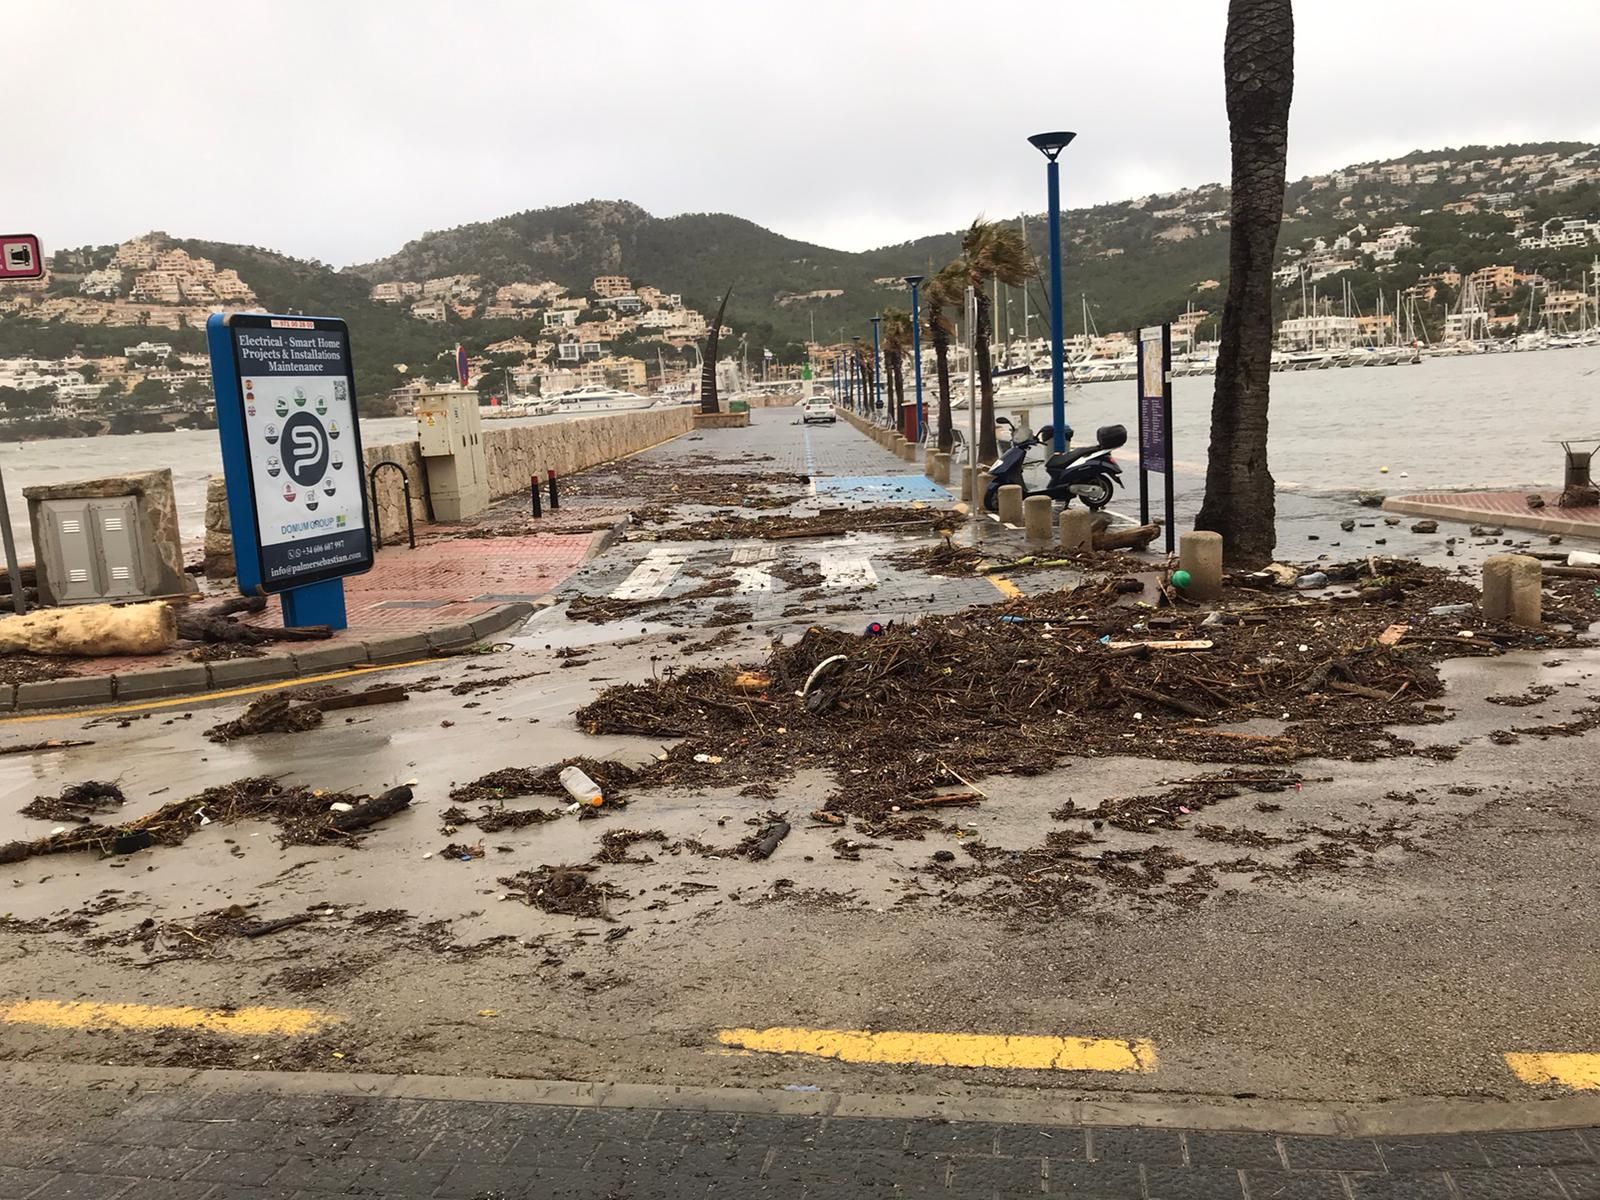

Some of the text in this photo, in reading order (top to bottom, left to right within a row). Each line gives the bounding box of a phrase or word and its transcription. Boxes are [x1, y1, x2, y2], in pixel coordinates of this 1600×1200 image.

[239, 335, 283, 347] Electrical
[289, 337, 316, 348] Smart
[317, 338, 340, 348] Home
[242, 348, 341, 361] Projects & Installations
[268, 361, 324, 372] Maintenance
[302, 545, 313, 555] +34
[271, 551, 362, 577] info@palmersebastian.com
